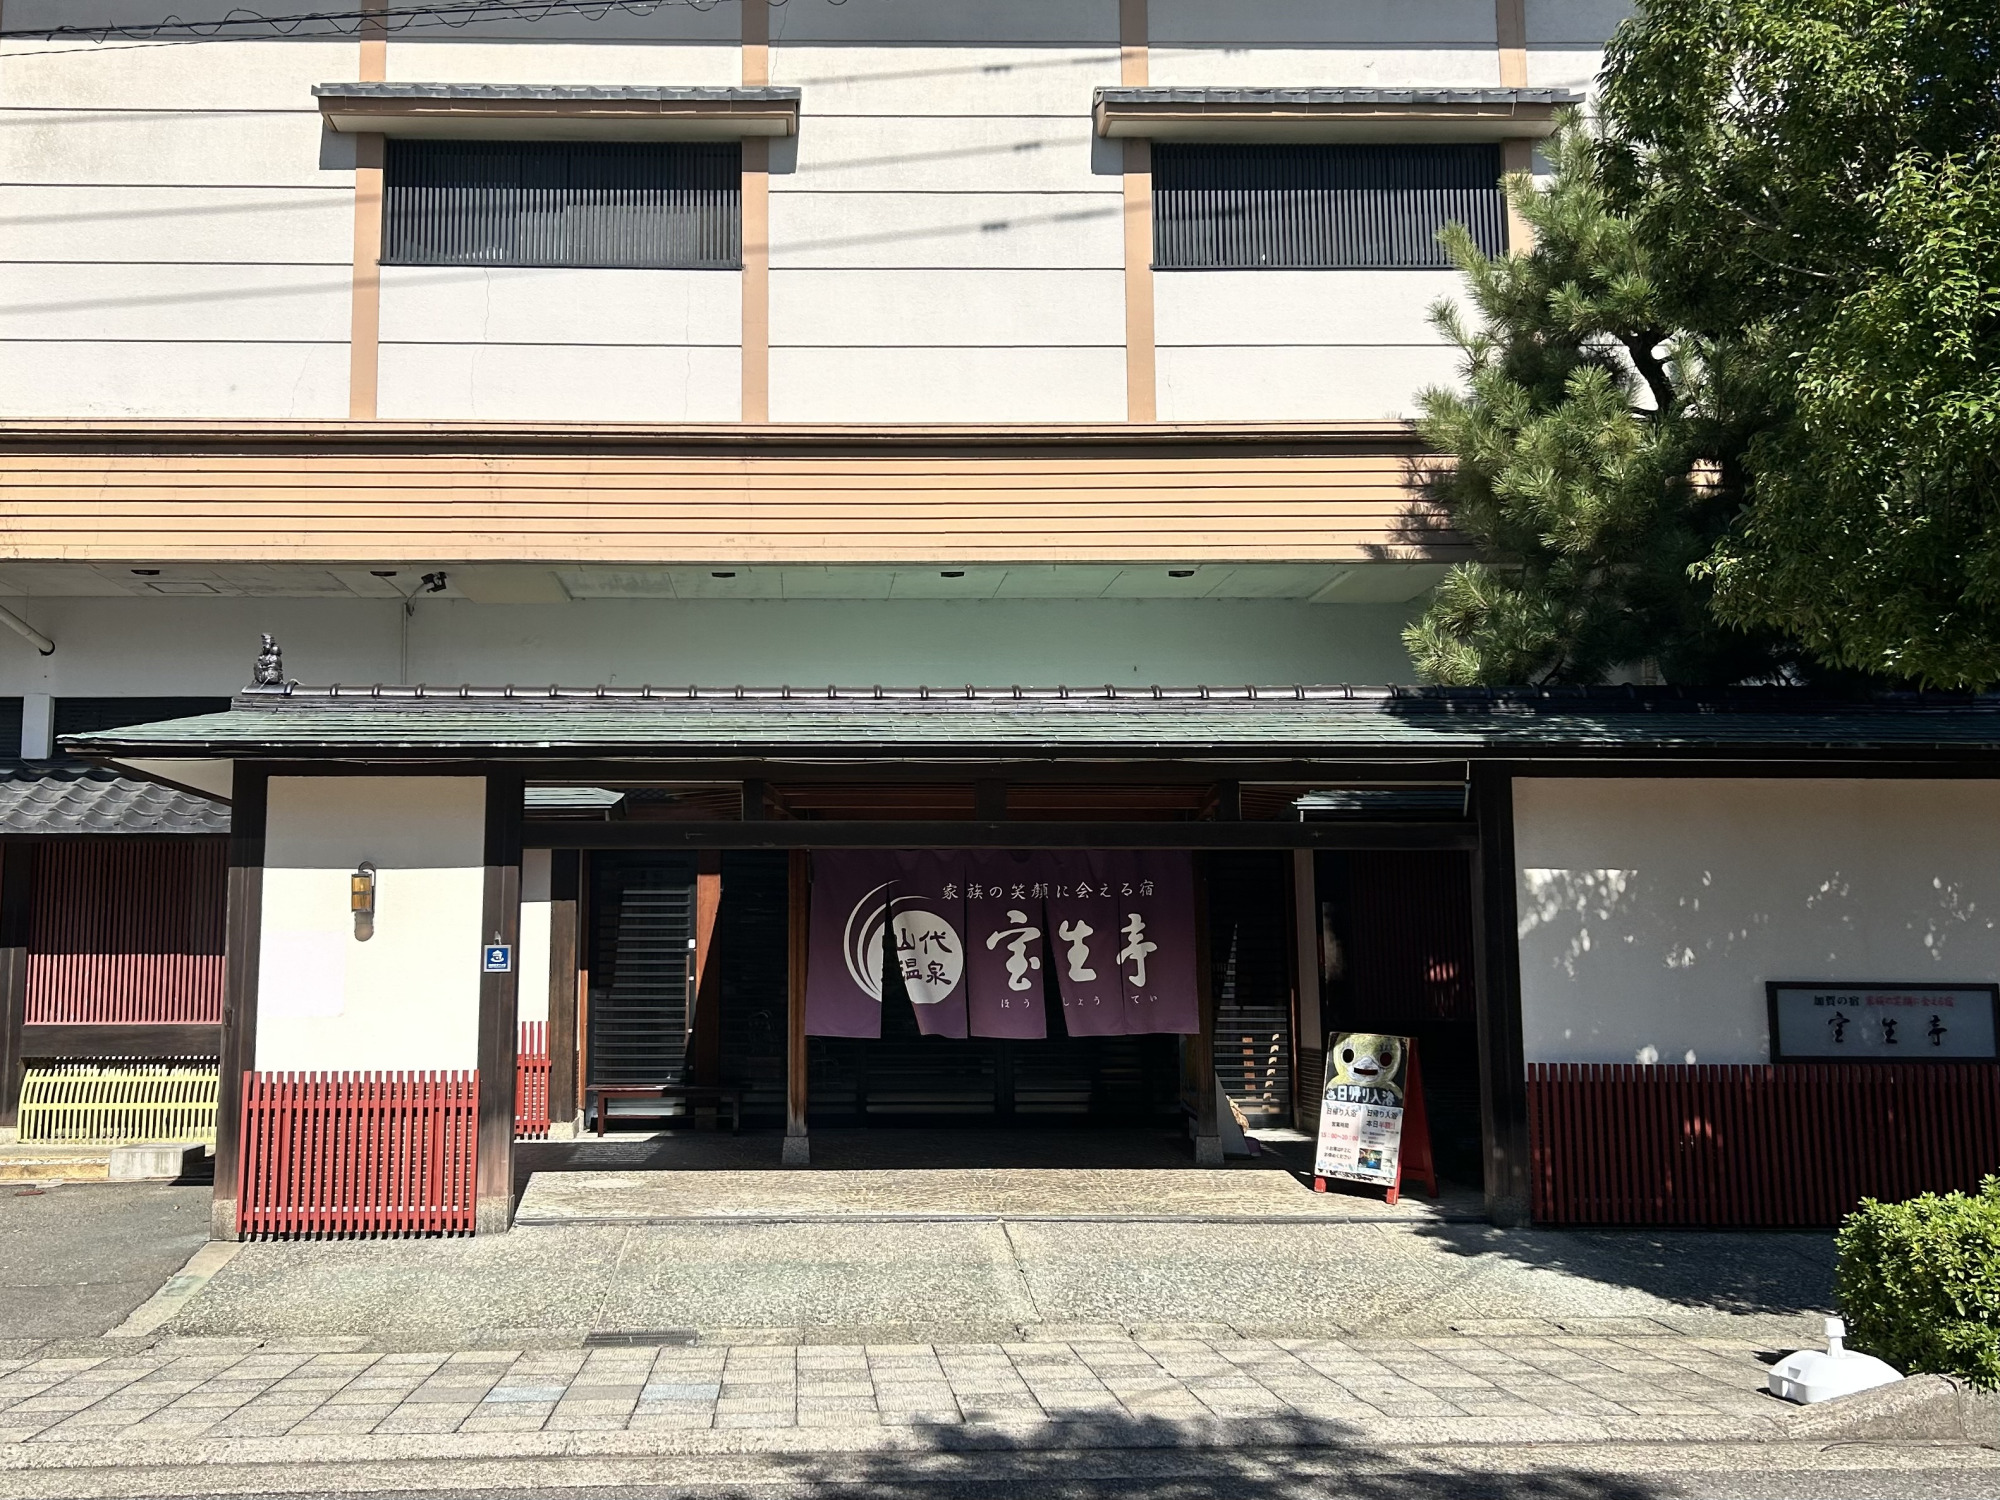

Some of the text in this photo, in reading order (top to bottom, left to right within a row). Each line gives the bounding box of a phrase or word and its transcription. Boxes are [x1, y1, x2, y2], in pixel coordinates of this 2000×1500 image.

[942, 879, 1154, 900] 家族の笑顔に会える宿
[896, 927, 953, 955] 山代
[986, 909, 1158, 993] 宝生亭
[900, 958, 952, 986] 温泉
[1814, 995, 1859, 1007] 加賀の宿
[1337, 1085, 1395, 1106] 日帰り入浴
